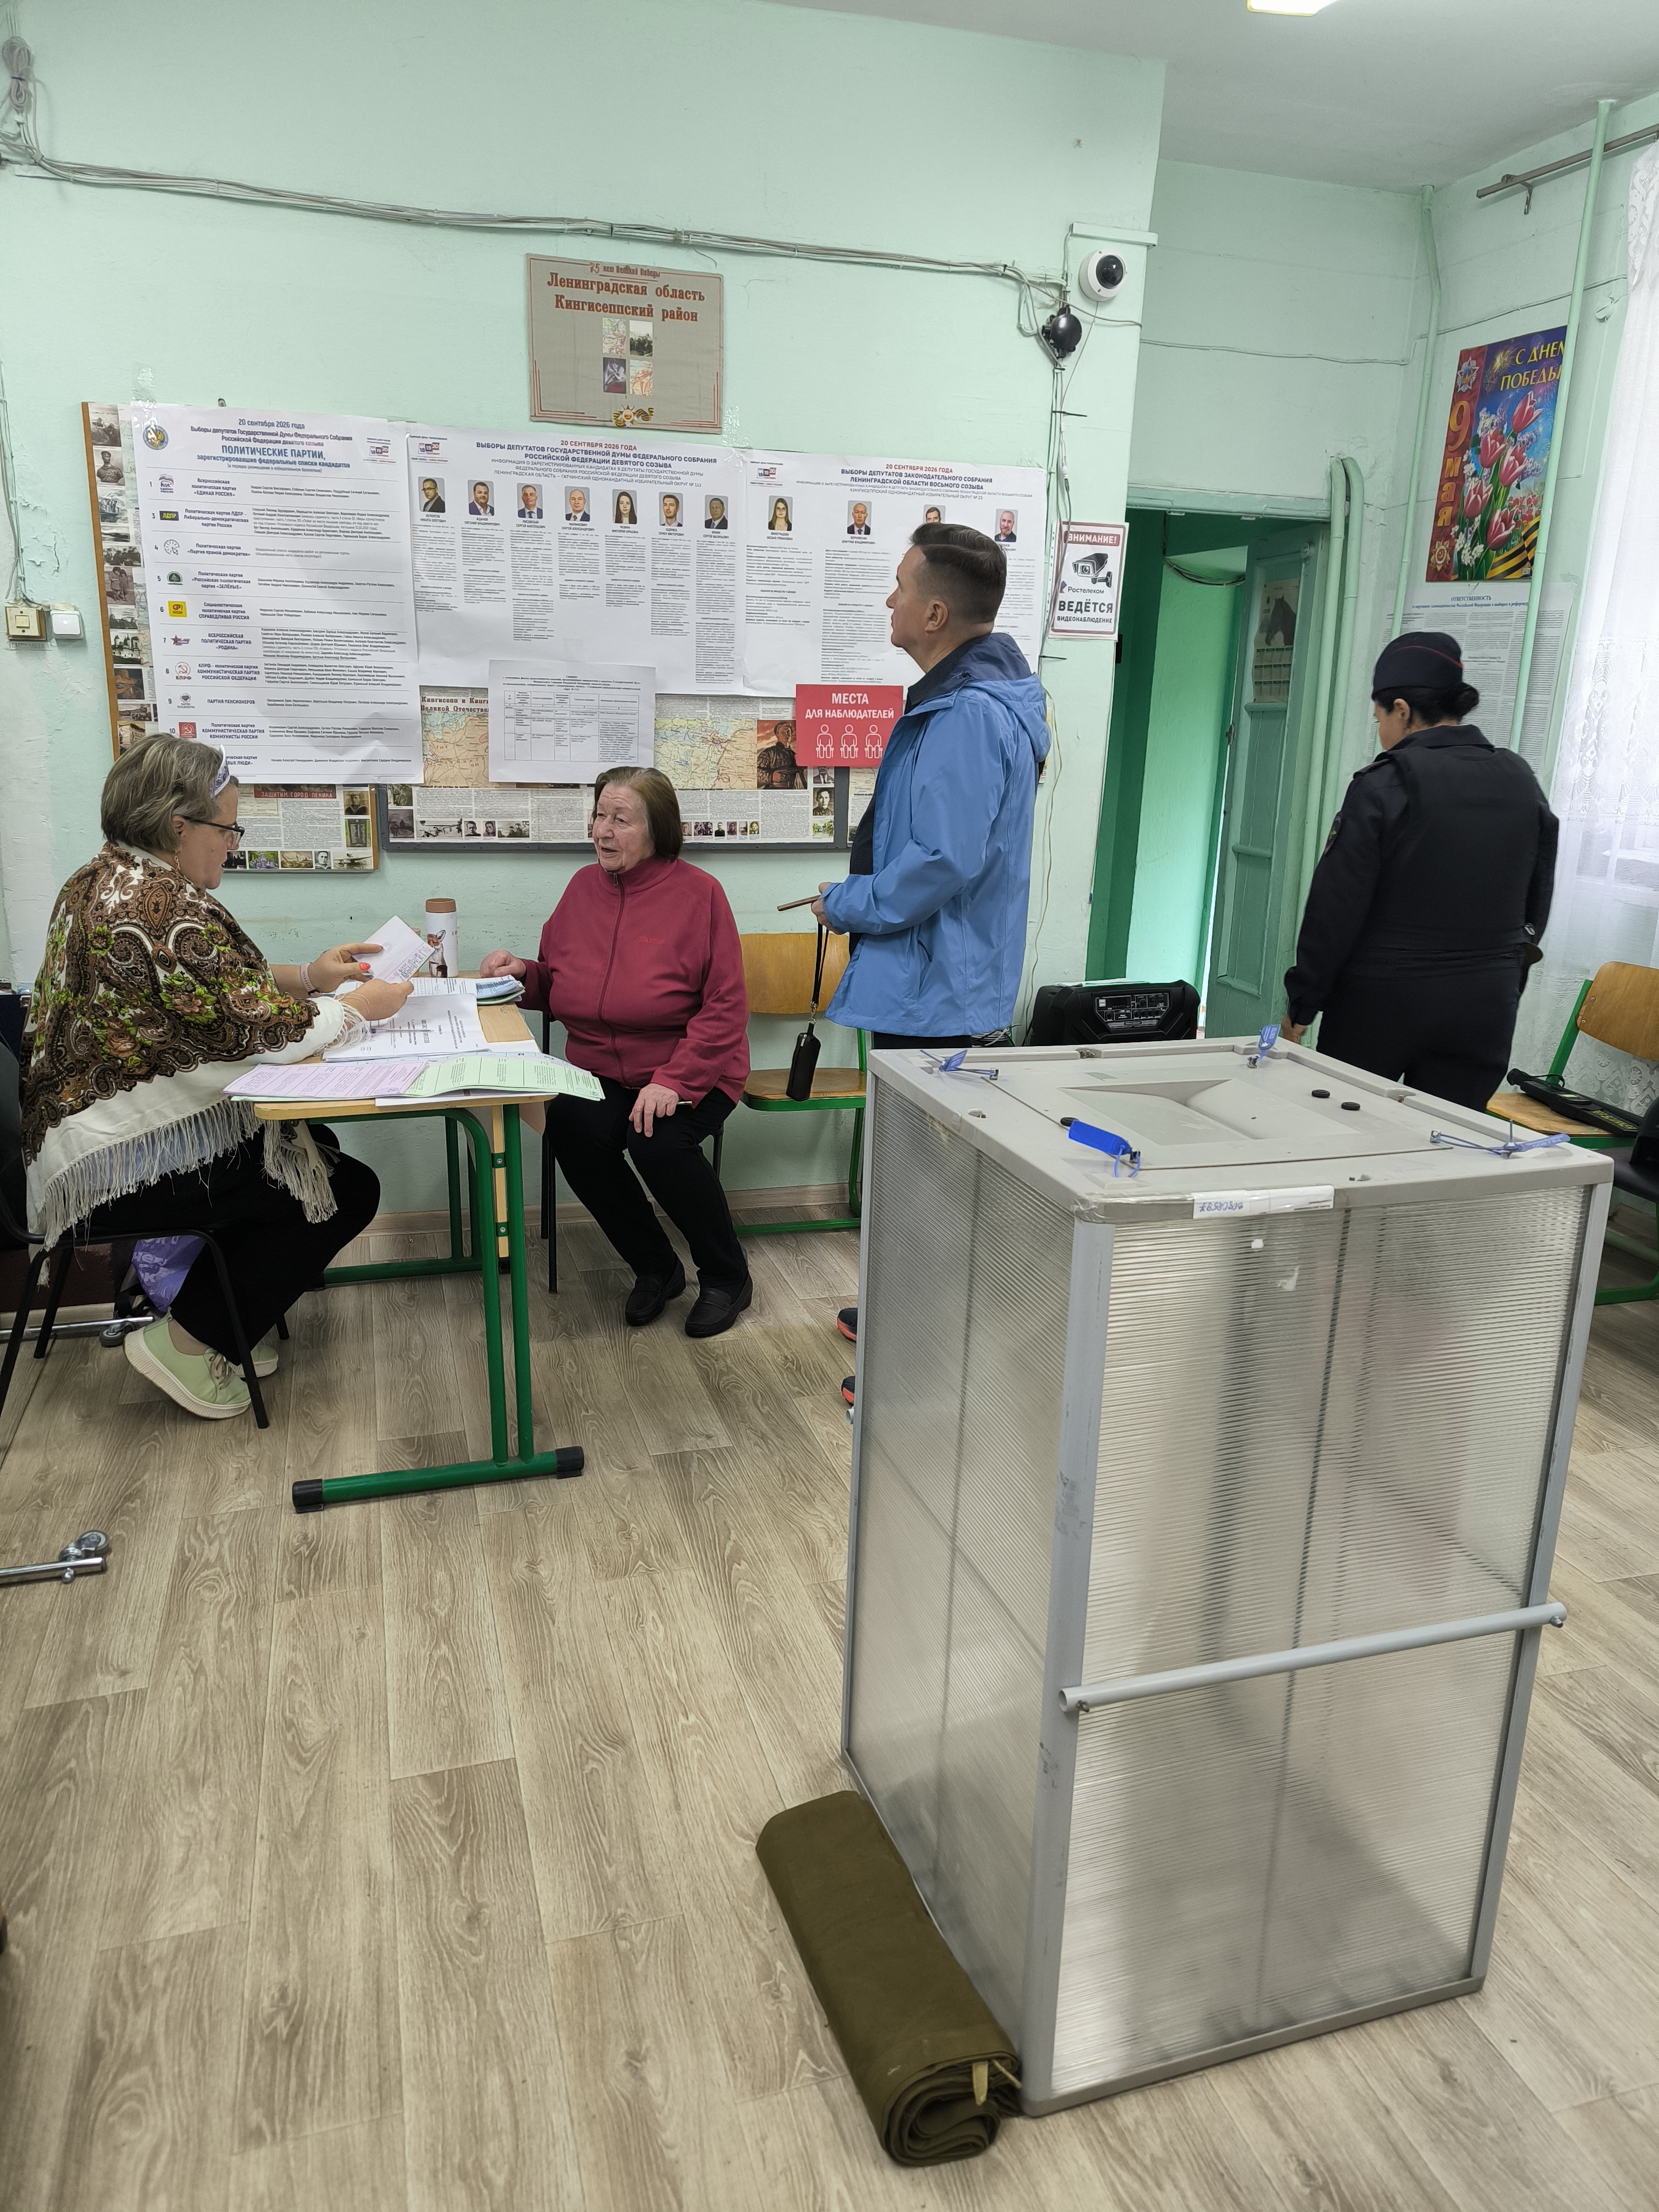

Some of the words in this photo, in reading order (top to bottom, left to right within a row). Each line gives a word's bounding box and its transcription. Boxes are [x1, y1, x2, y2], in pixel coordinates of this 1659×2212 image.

[590, 262, 600, 274] 75
[640, 268, 660, 278] Победы
[547, 272, 648, 295] Ленинградская
[655, 284, 705, 301] область
[555, 294, 655, 318] Кингисеппский
[661, 306, 699, 322] район
[1515, 348, 1526, 365] С
[1500, 365, 1562, 391] ПОБЕДЫ
[1448, 400, 1471, 451] 9
[222, 446, 288, 457] ПОЛИТИЧЕСКИЕ
[291, 449, 325, 461] ПАРТИИ,
[524, 453, 570, 462] РОССИЙСКОЙ
[571, 456, 610, 465] ФЕДЕРАЦИИ
[611, 459, 644, 467] ДЕВЯТОГО
[547, 447, 610, 457] ГОСУДАРСТВЕННОЙ
[632, 453, 682, 462] ФЕДЕРАЛЬНОГО
[531, 461, 585, 469] ЗАРЕГИСТРИРОВАННЫХ
[850, 477, 901, 485] ЛЕНИНГРАДСКОЙ
[904, 473, 962, 481] ЗАКОНОДАТЕЛЬНОГО
[1068, 533, 1117, 544] ВНИМАНИЕ!
[1058, 598, 1113, 613] ВЕДЁТСЯ
[832, 693, 869, 705] МЕСТА
[805, 709, 822, 719] ДЛЯ
[825, 708, 894, 720] НАБЛЮДАТЕЛЕЙ
